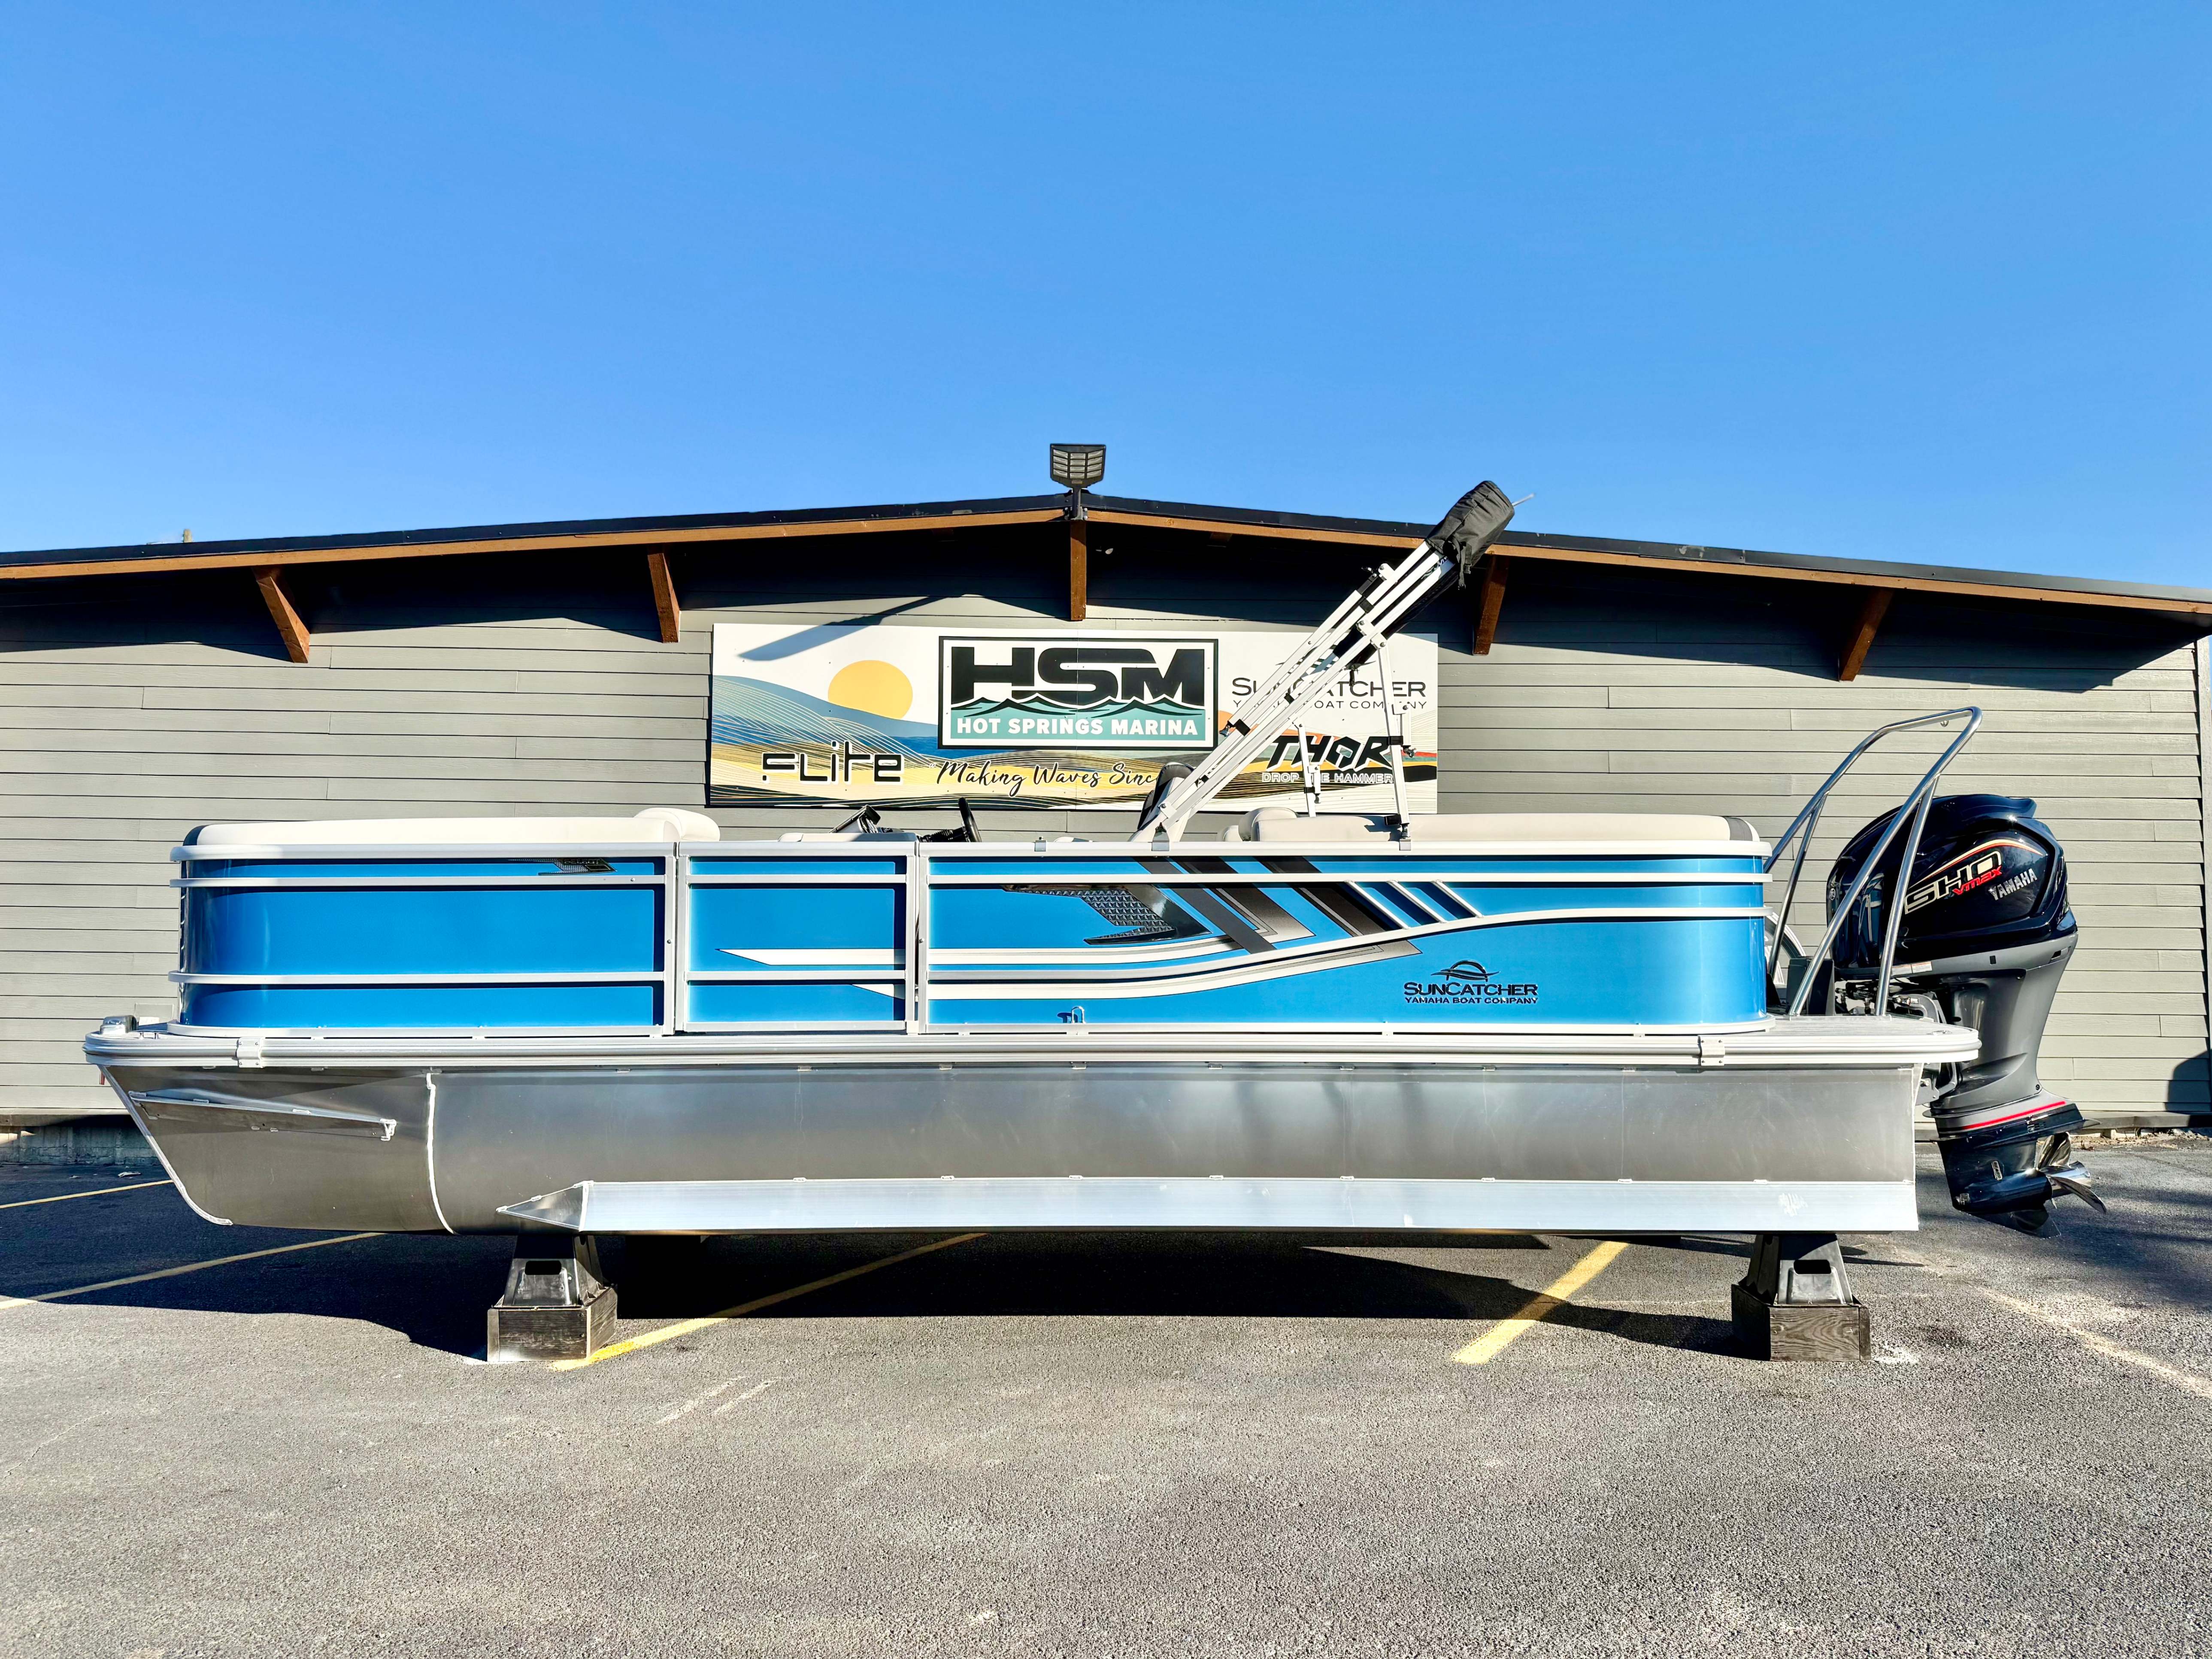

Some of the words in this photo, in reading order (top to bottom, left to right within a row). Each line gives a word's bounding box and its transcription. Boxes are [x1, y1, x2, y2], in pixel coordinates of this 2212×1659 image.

[951, 646, 1205, 706] HSM
[1232, 677, 1426, 697] STCHER
[1314, 701, 1345, 709] OAT
[1350, 701, 1427, 709] COMNY
[957, 717, 1001, 734] HOT
[1008, 718, 1104, 735] SPRINGS
[1111, 719, 1198, 735] MARINA
[1266, 735, 1391, 770] THOR
[1033, 762, 1102, 788] Waves
[1109, 763, 1158, 786] Sinc
[1262, 772, 1300, 783] DROP
[1334, 773, 1394, 784] HAMMER
[1905, 850, 2002, 915] SHO
[1988, 868, 2038, 901] YAMAHA
